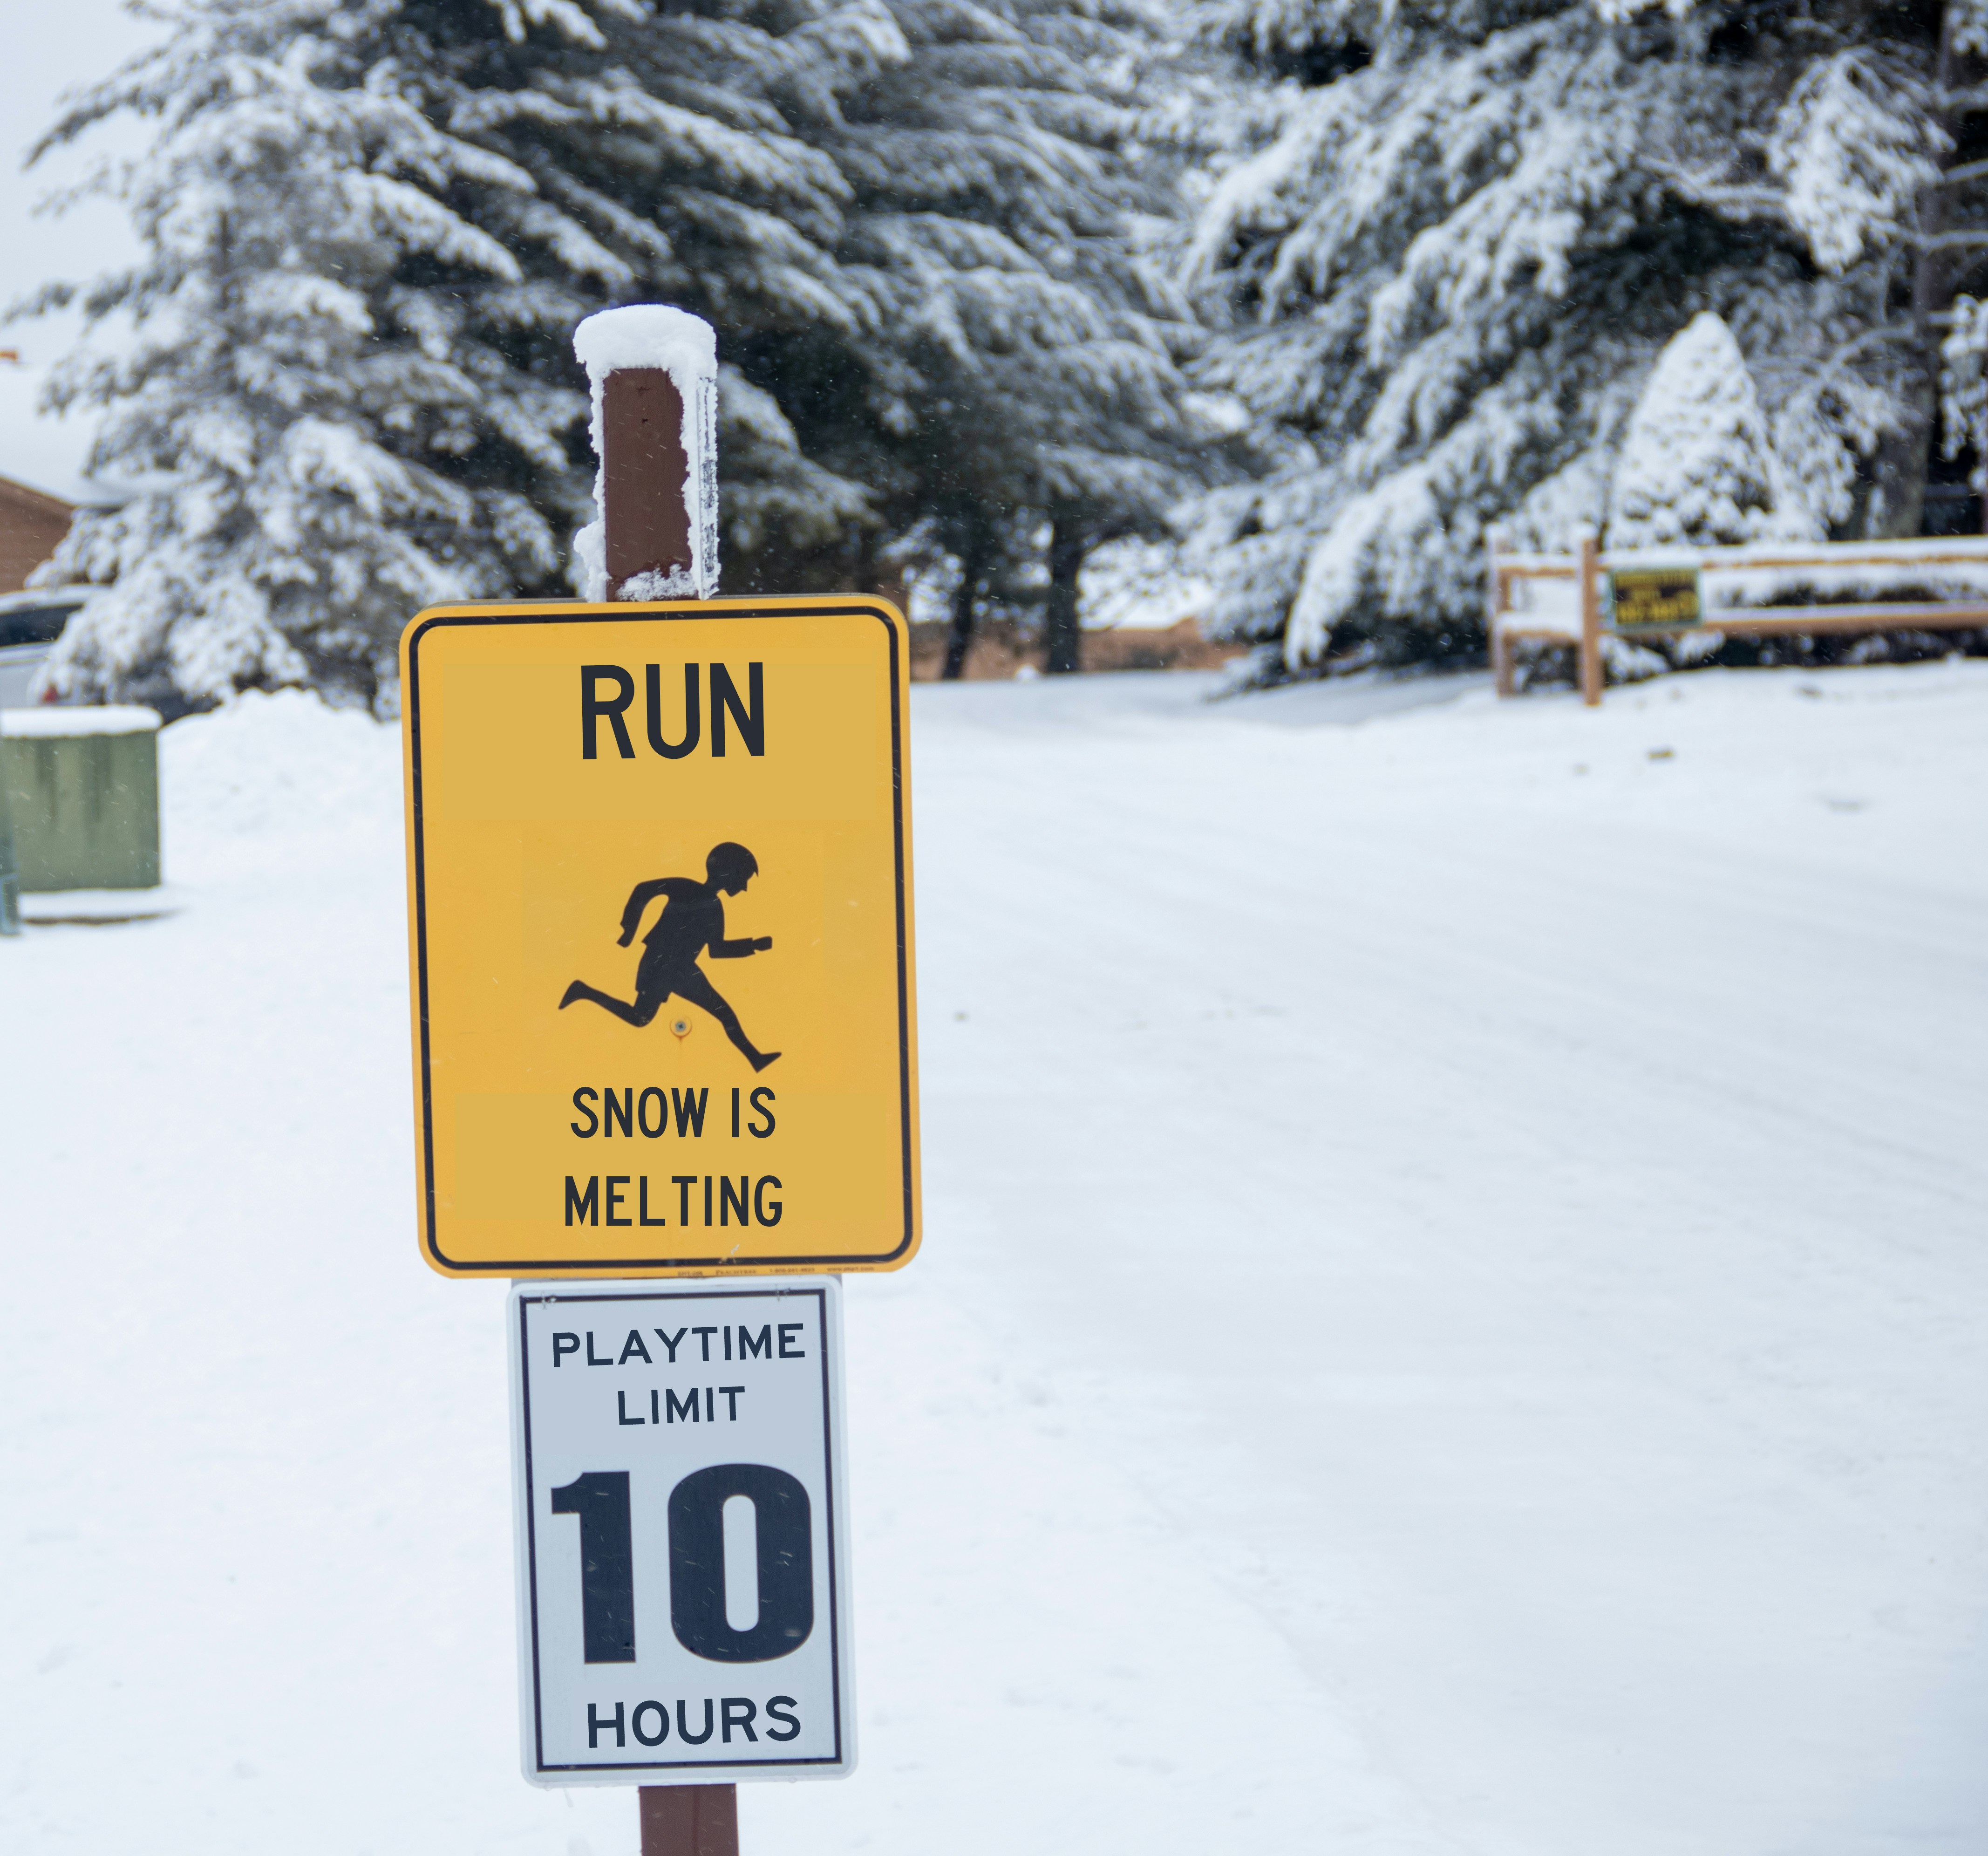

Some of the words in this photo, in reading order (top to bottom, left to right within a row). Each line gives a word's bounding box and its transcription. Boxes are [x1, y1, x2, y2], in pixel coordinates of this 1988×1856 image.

[581, 662, 765, 759] RUN
[571, 1087, 709, 1138] SNOW
[732, 1087, 776, 1138] IS
[565, 1175, 783, 1227] MELTING
[552, 1324, 805, 1367] PLAYTIME
[618, 1386, 745, 1425] LIMIT
[551, 1464, 814, 1664] 10
[587, 1696, 801, 1748] HOURS
